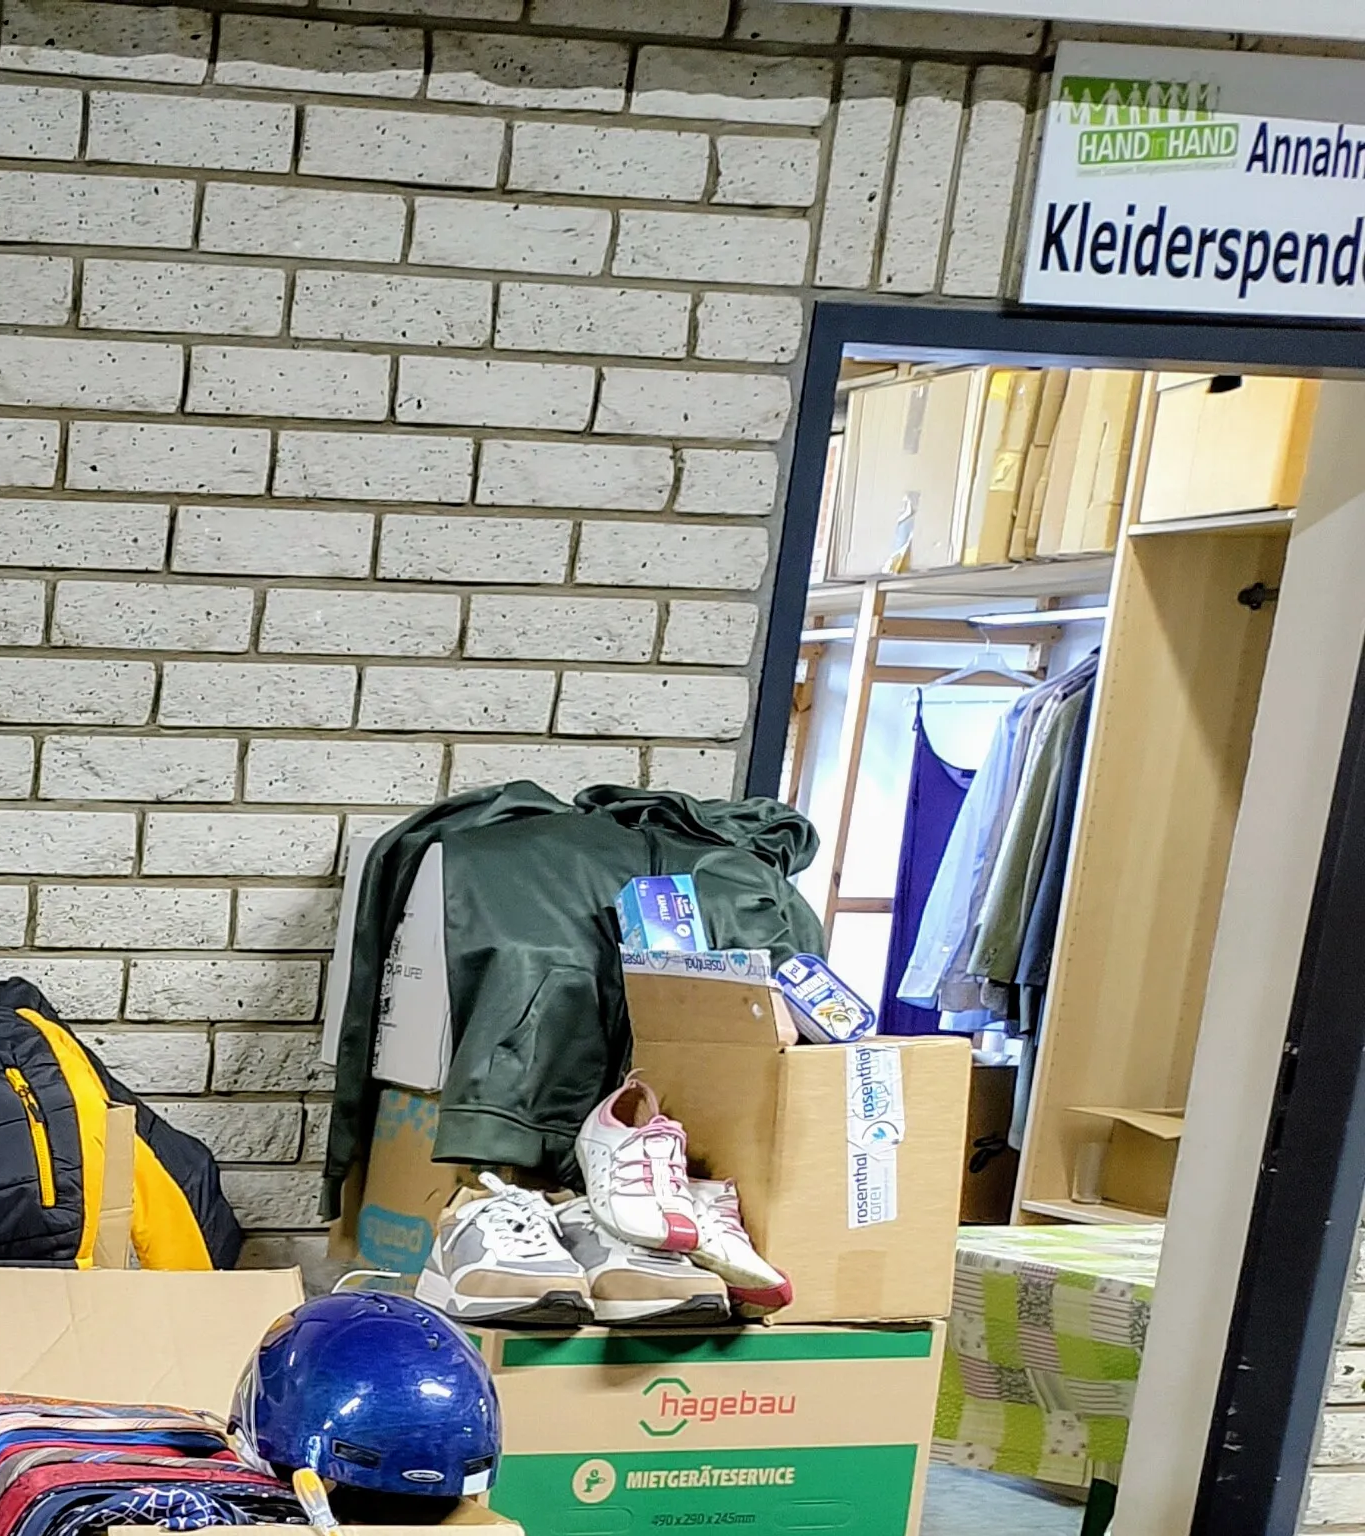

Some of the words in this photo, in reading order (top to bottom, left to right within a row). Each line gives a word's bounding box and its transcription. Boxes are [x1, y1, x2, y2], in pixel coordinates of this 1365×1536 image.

[1039, 201, 1365, 299] Kleiderspend
[852, 1152, 868, 1224] rosenthal
[660, 1390, 796, 1423] hagebau
[625, 1465, 795, 1491] MIETGERÄTESERVICE
